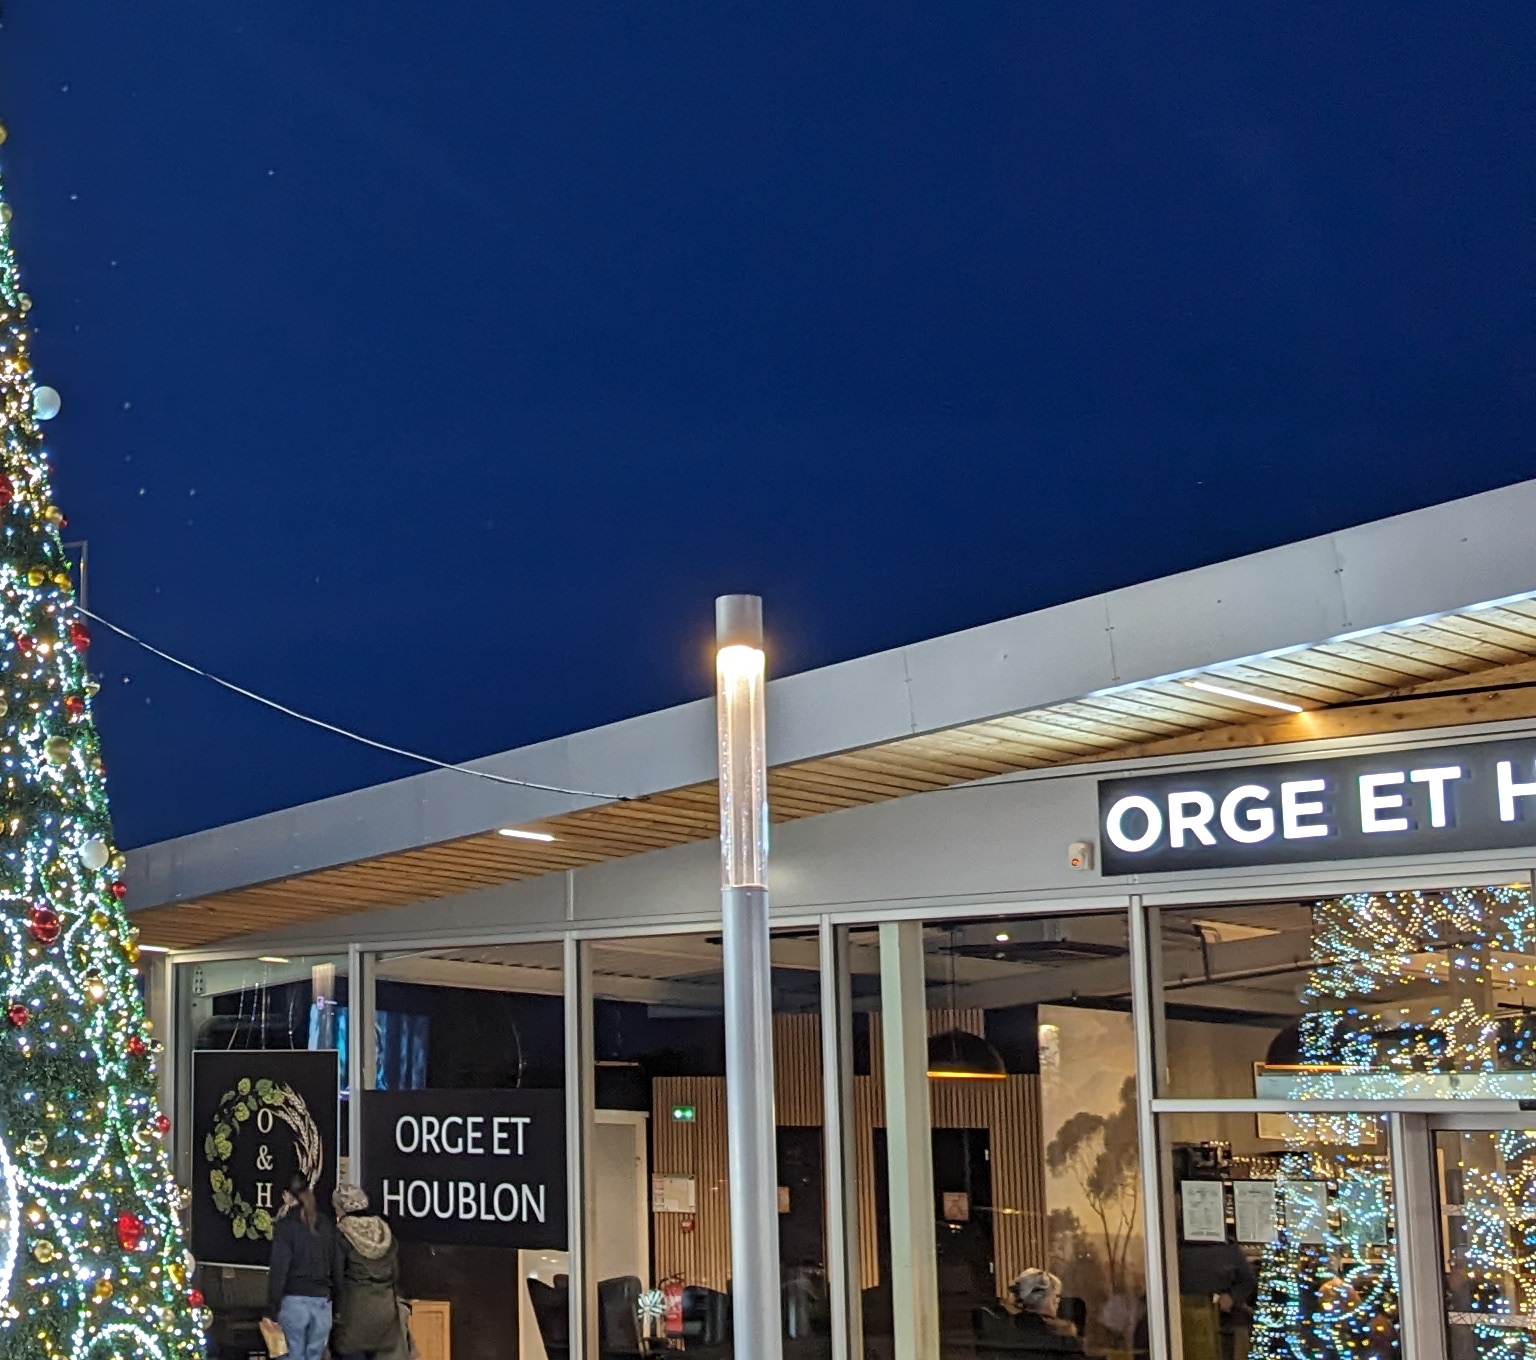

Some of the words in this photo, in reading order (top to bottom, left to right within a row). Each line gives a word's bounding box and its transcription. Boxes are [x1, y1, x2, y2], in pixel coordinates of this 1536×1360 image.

[1105, 778, 1328, 853] ORGE
[1358, 765, 1462, 834] ET
[256, 1107, 273, 1134] O
[395, 1115, 484, 1155] ORGE
[492, 1116, 531, 1155] ET
[256, 1144, 274, 1171] &
[255, 1181, 273, 1208] H
[382, 1178, 545, 1223] HOUBLON
